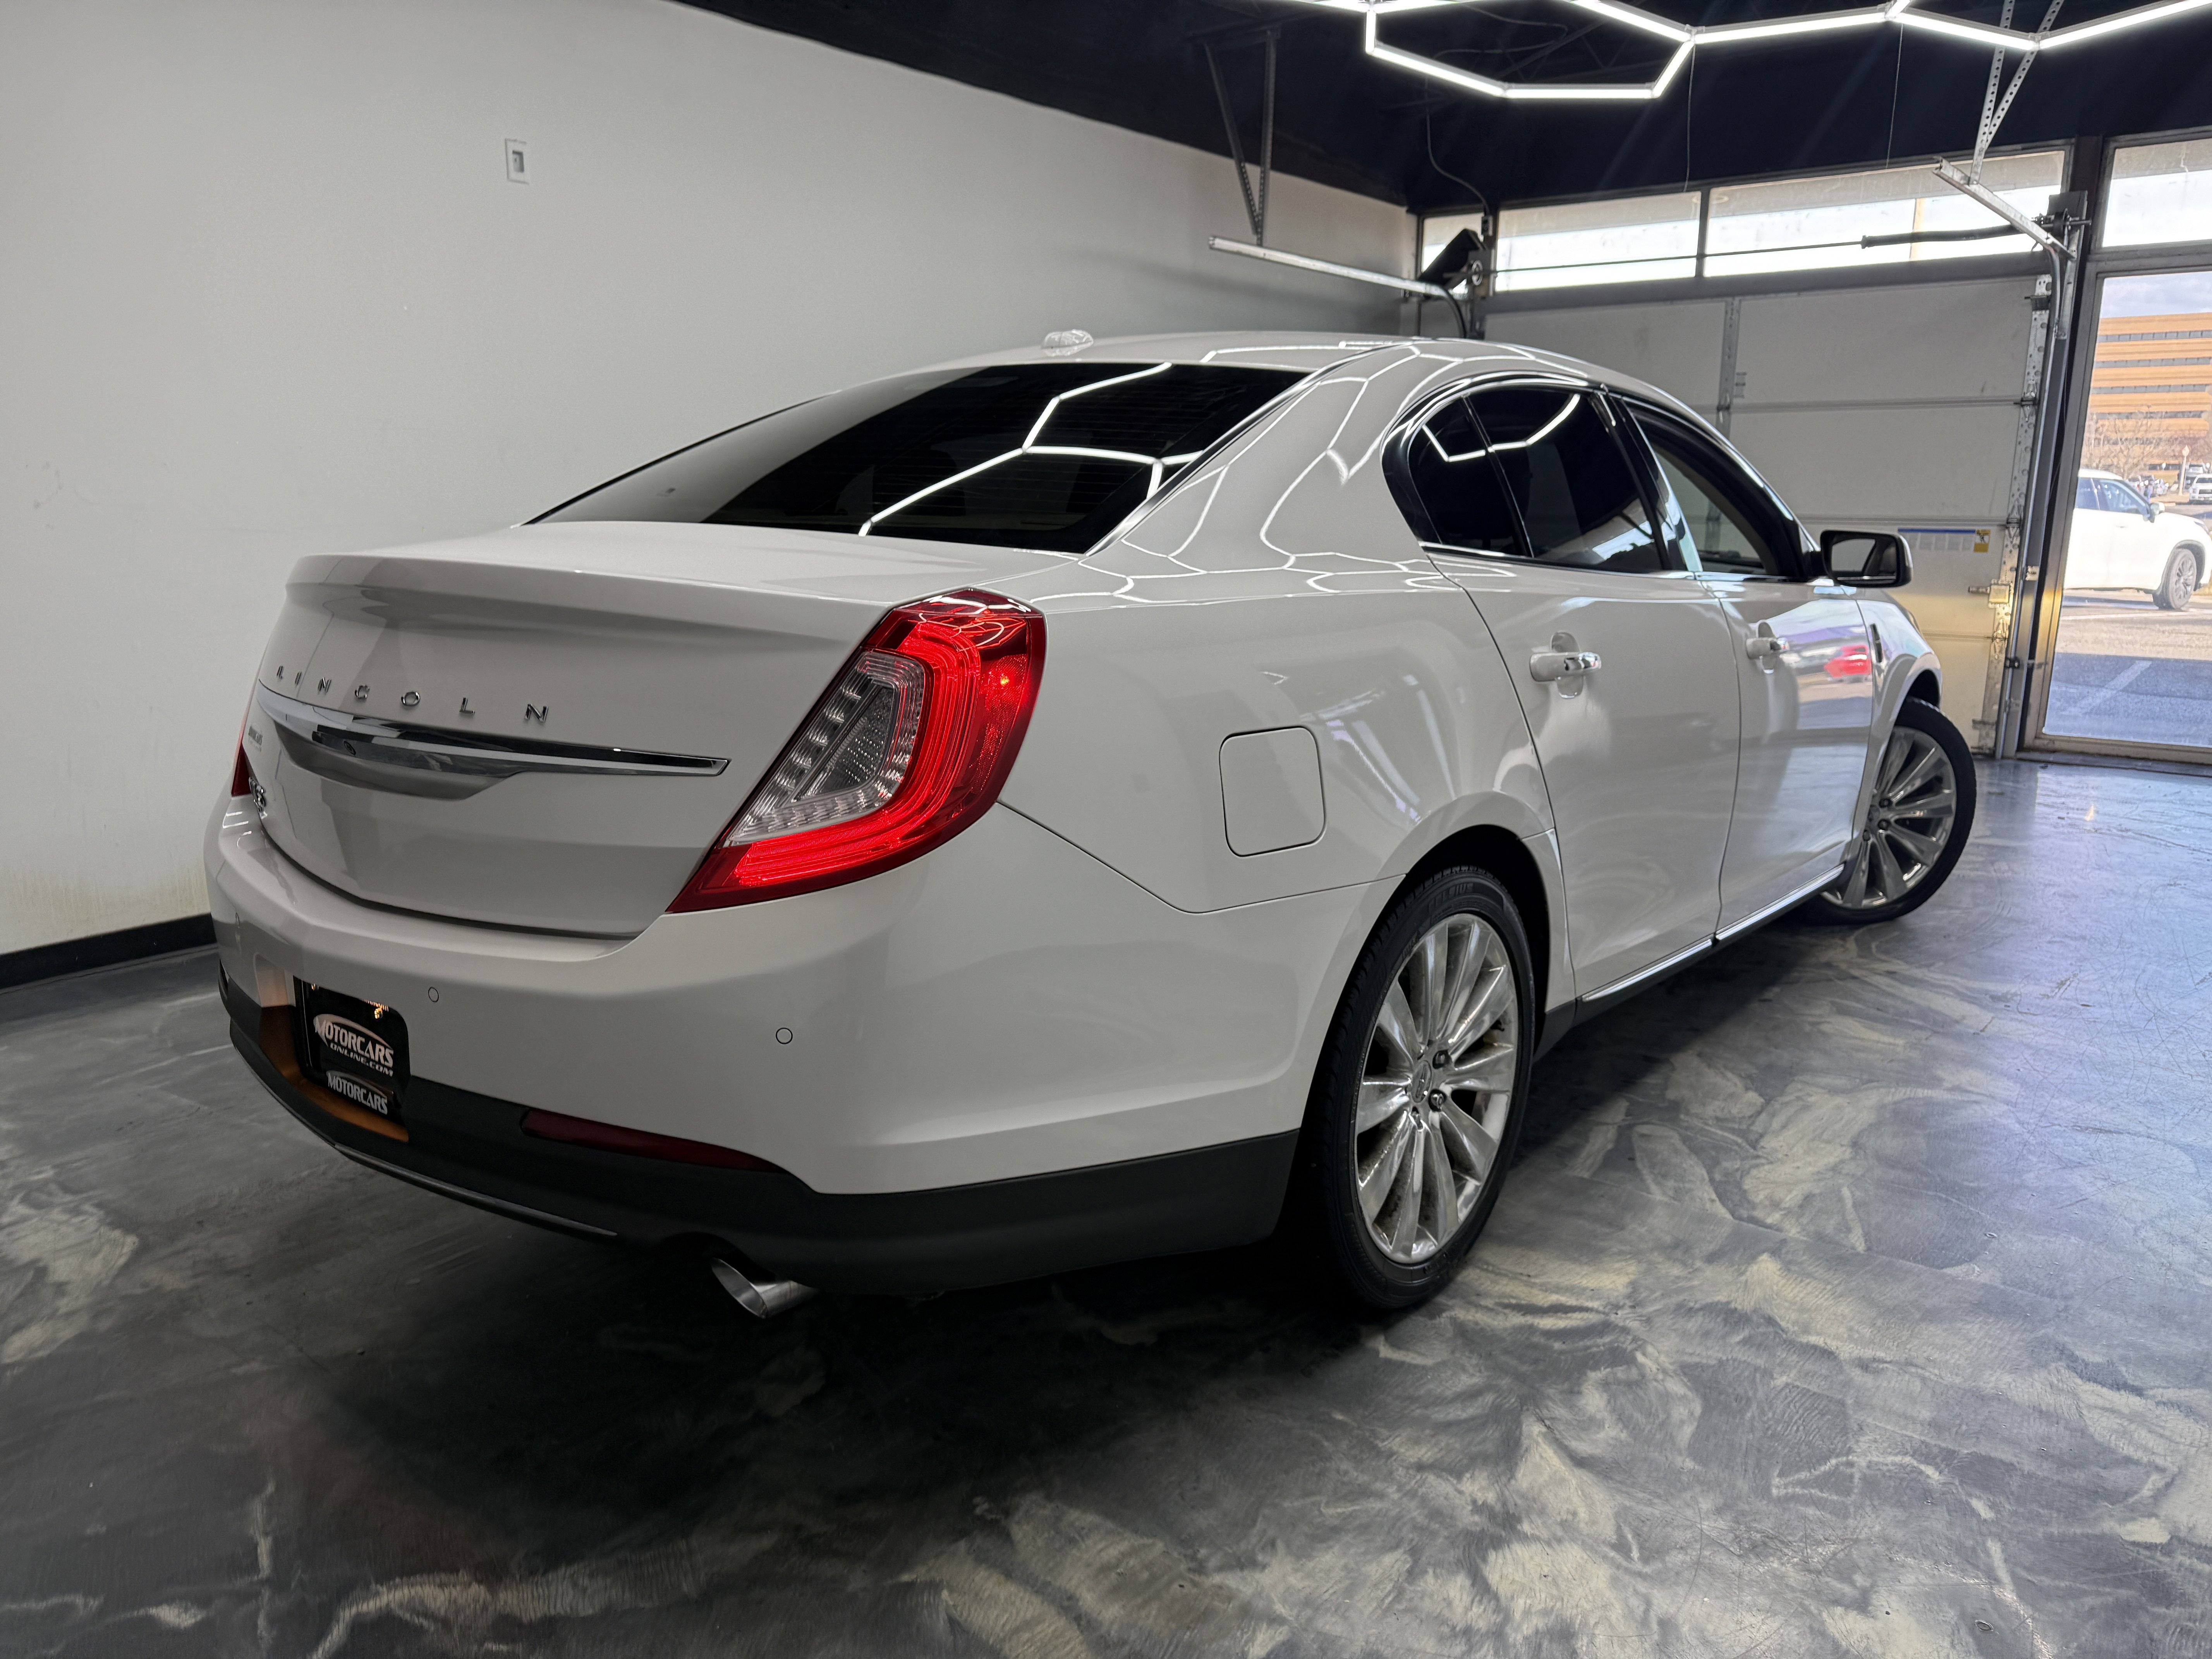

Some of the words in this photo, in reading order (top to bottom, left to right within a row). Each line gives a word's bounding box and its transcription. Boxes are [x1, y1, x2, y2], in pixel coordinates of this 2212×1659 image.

[276, 665, 549, 723] LINCOLN
[315, 1018, 394, 1068] MOTORCARS
[330, 1042, 393, 1078] ONLINE.COM
[328, 1073, 388, 1115] MOTORCARS
